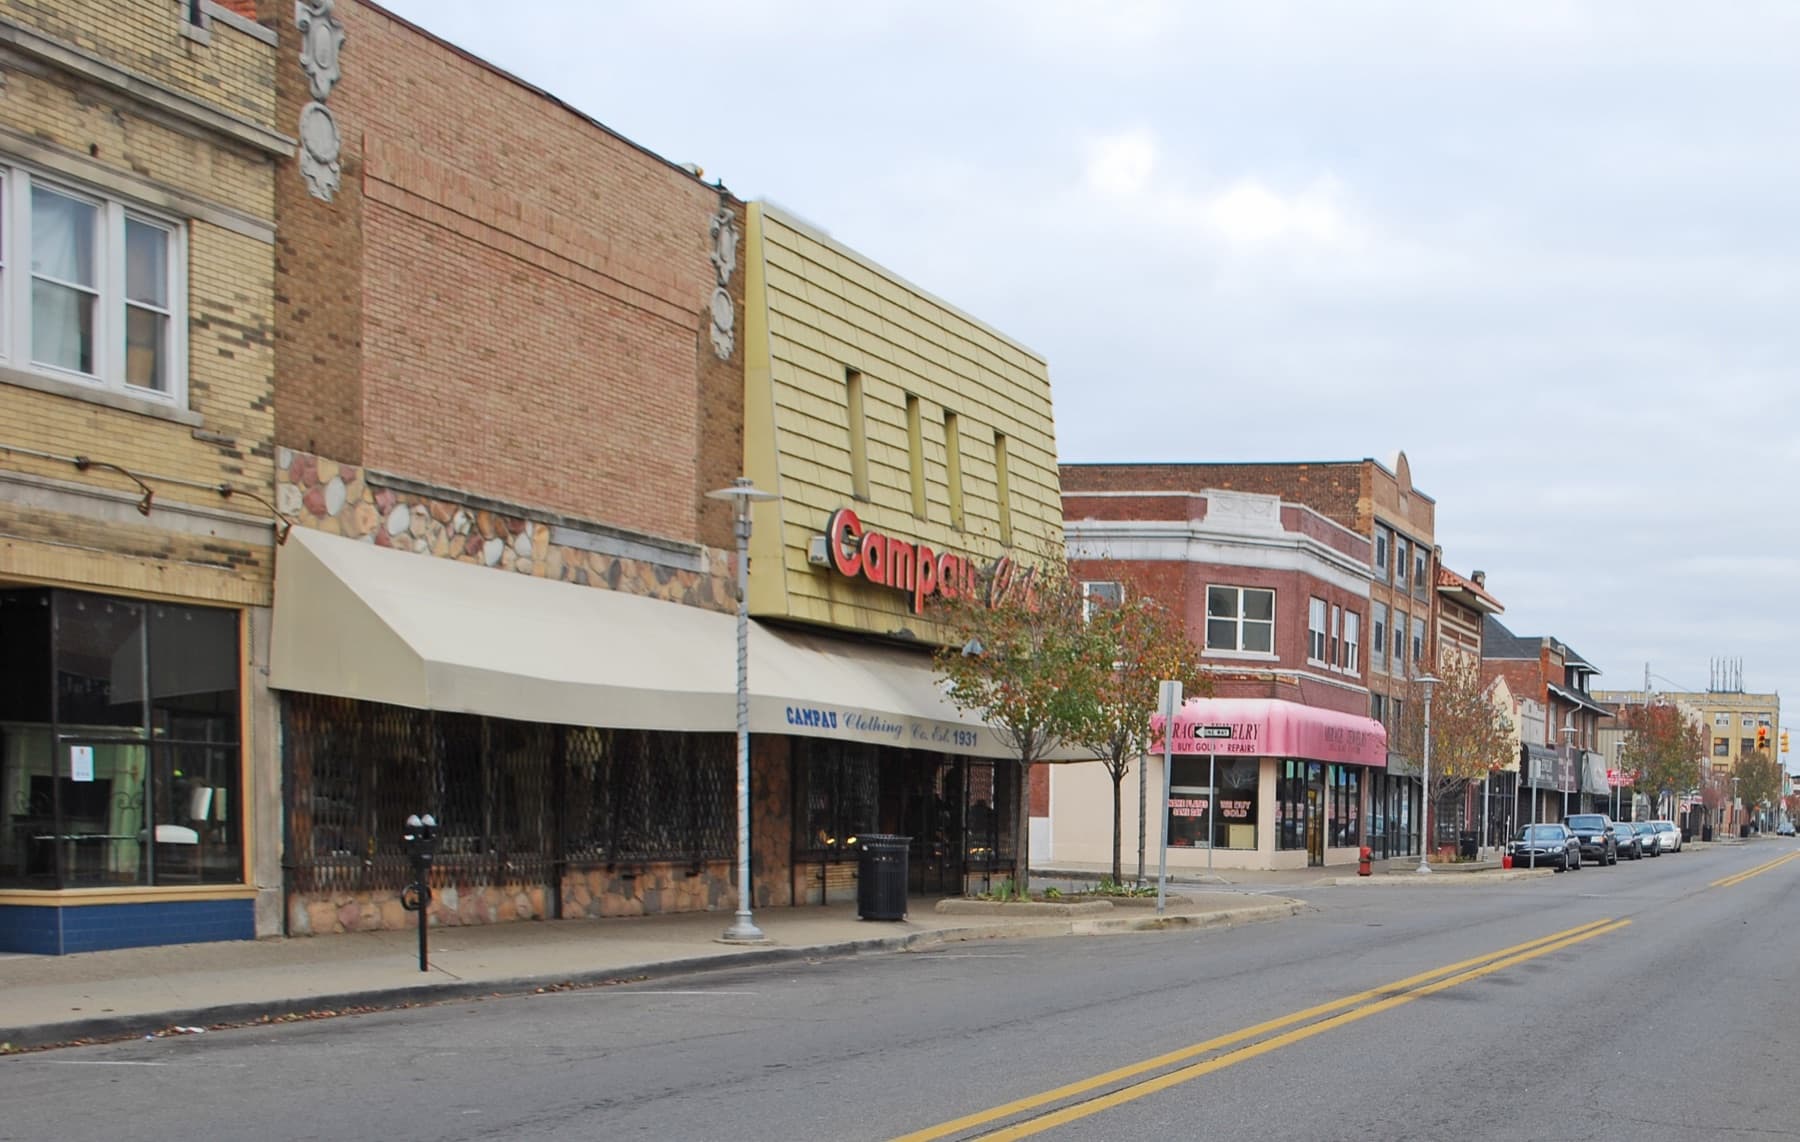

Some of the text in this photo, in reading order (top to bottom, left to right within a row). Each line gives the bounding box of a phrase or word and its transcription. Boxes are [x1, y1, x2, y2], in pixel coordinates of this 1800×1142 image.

[825, 508, 975, 615] Campau
[786, 706, 837, 729] CAMPAU
[842, 713, 903, 739] Clothing
[952, 730, 977, 747] 1931
[1177, 743, 1191, 751] BUY
[1227, 743, 1255, 753] REPAIRS
